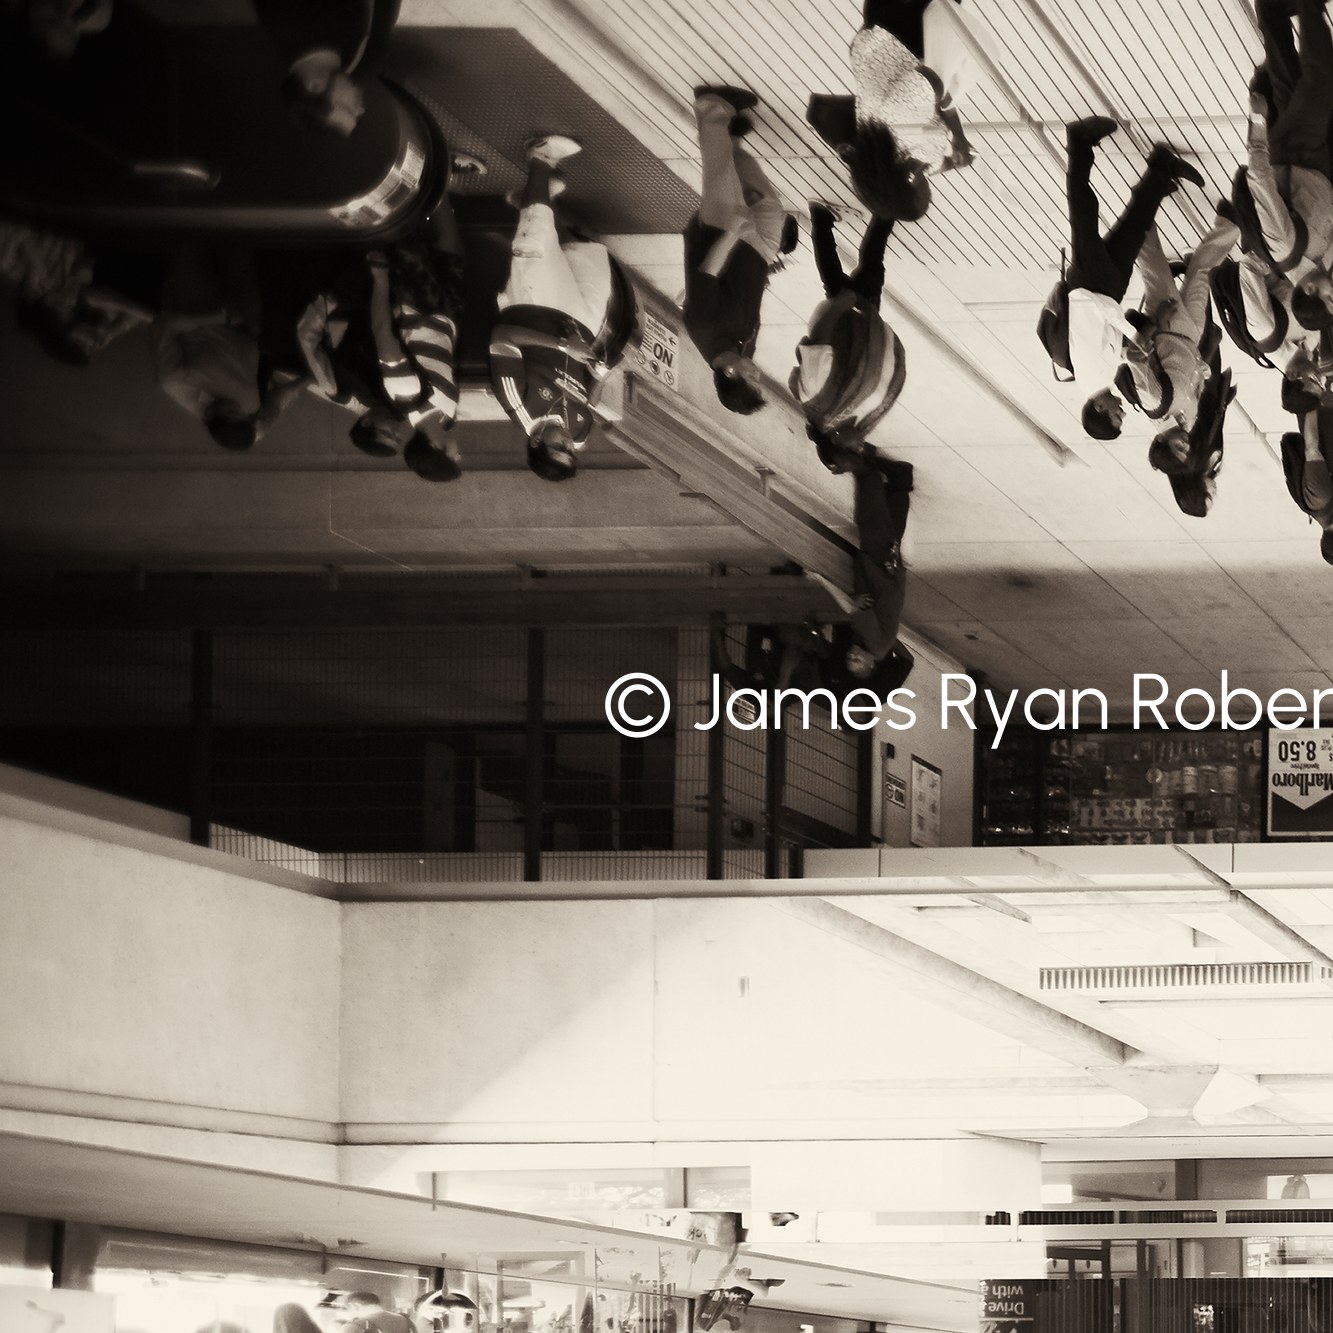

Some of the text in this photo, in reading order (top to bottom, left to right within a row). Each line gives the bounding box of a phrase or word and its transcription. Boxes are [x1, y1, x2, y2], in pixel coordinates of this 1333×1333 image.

[652, 342, 673, 367] NO
[1277, 740, 1317, 762] 8.50
[992, 1286, 1024, 1300] with
[987, 1301, 1025, 1316] Drive
